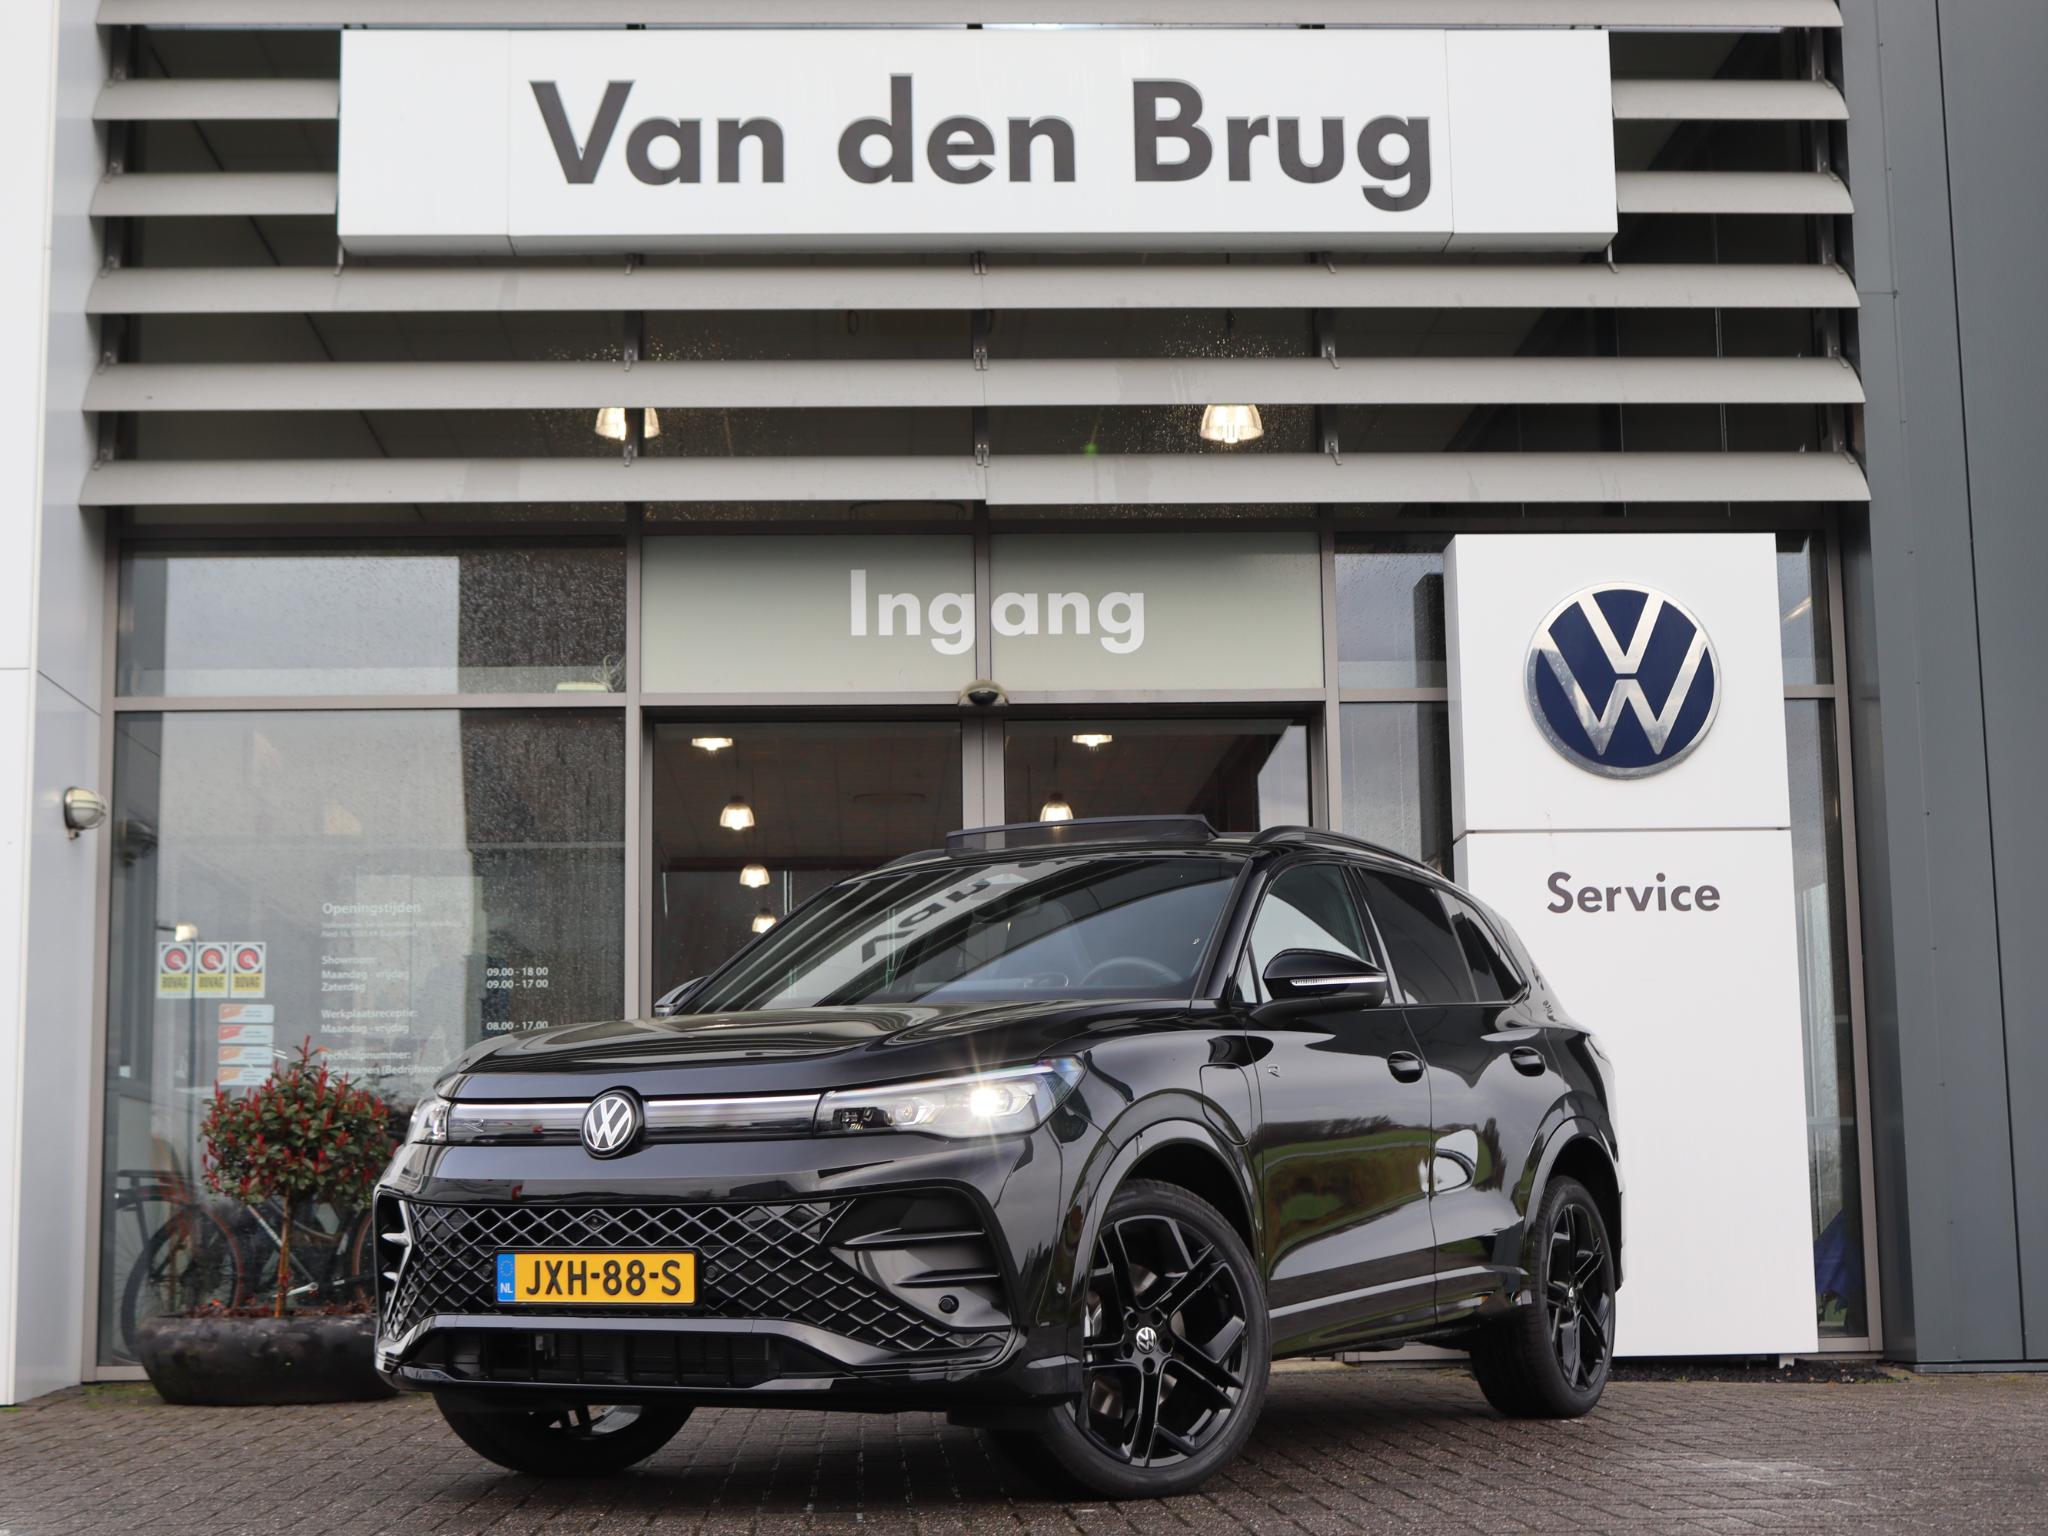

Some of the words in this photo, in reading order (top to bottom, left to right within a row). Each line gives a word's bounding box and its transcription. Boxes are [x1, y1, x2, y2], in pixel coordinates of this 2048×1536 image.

[529, 79, 785, 187] Van
[837, 72, 1077, 186] den
[1132, 77, 1432, 213] Brug
[850, 569, 1146, 656] Ingang
[1535, 588, 1709, 757] VW
[1546, 871, 1721, 914] Service
[584, 1097, 633, 1150] VW
[500, 1283, 513, 1294] NL
[526, 1259, 682, 1297] JXH-88-S
